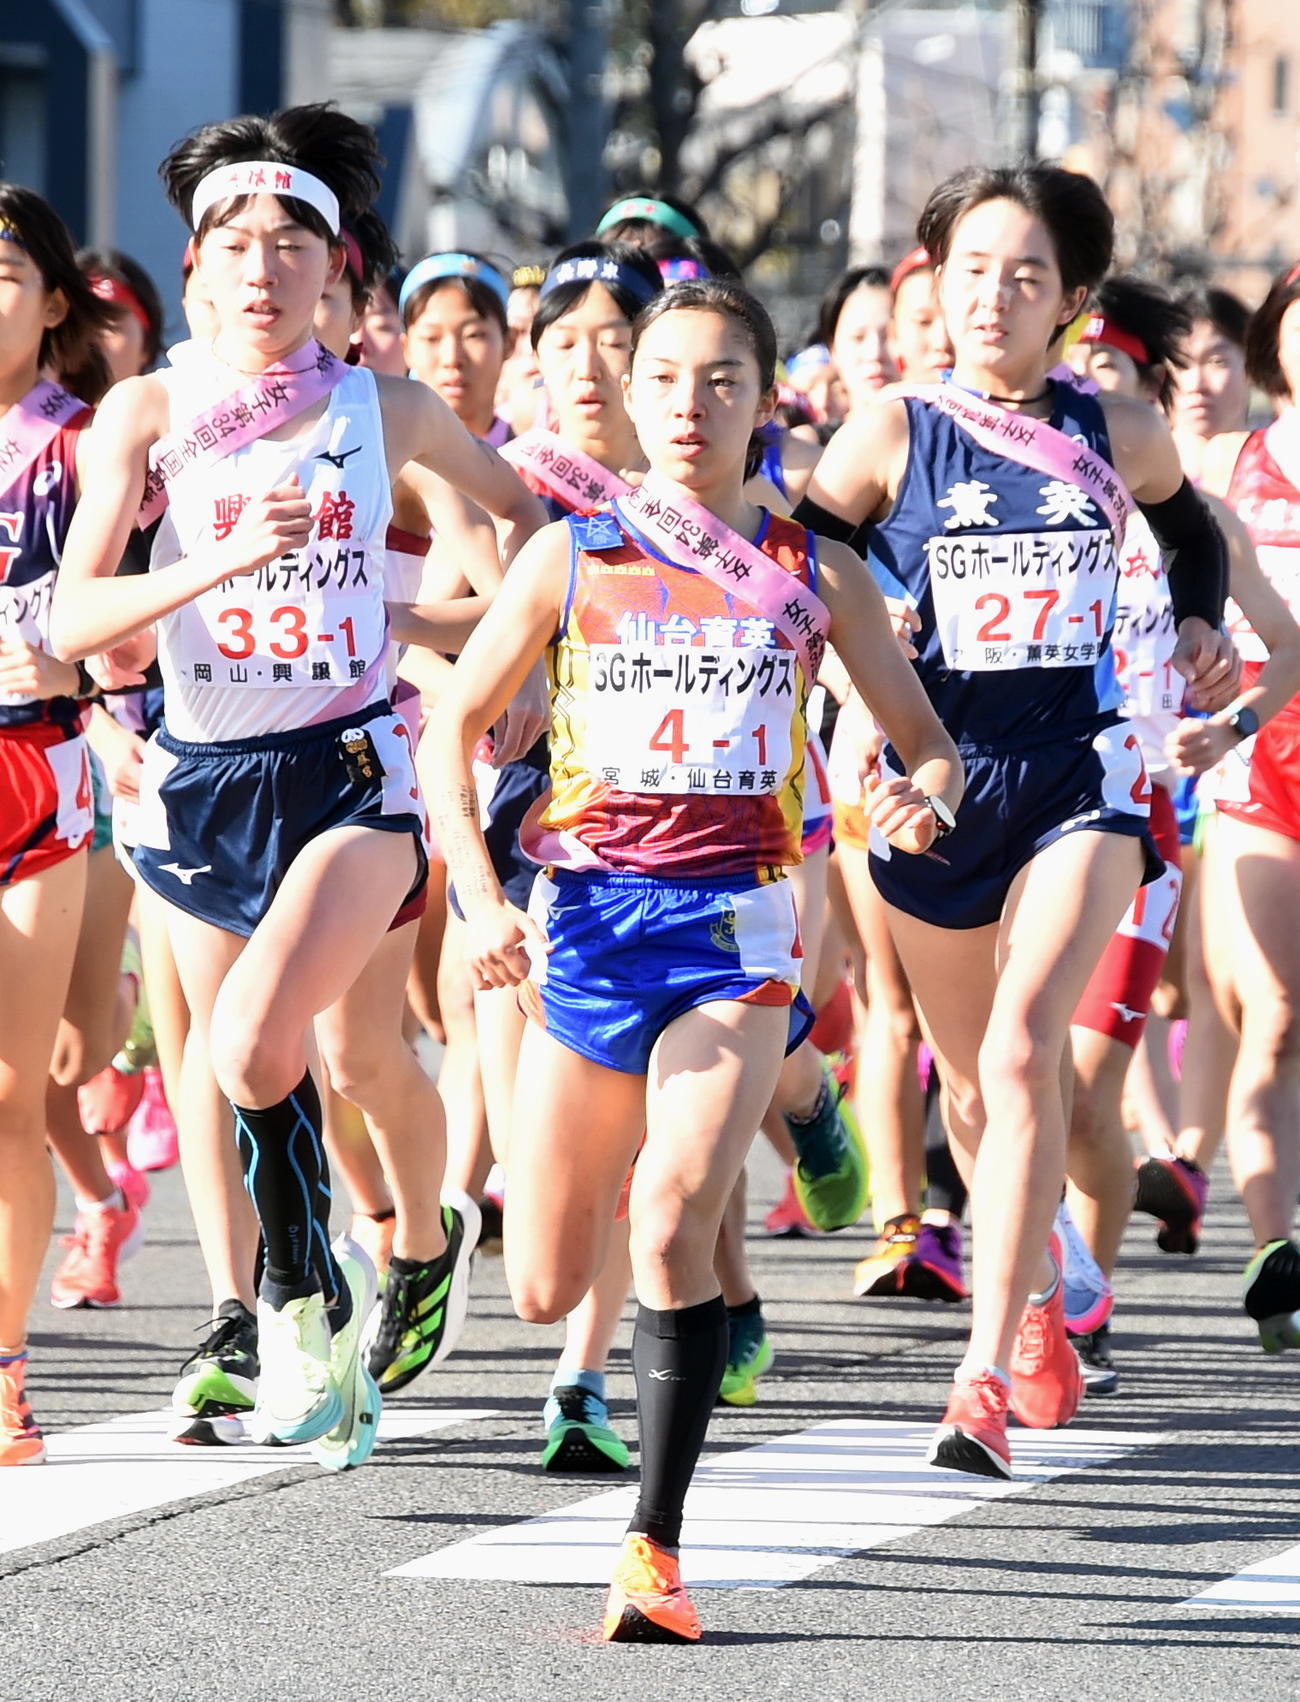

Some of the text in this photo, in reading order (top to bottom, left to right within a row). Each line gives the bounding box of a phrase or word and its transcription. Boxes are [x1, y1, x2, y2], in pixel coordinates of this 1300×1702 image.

[213, 490, 356, 541] 興館
[214, 547, 369, 594] ルディングス
[216, 605, 358, 661] 33-1
[616, 610, 777, 649] 仙台育英
[974, 588, 1103, 643] 27-1
[594, 651, 793, 699] SGホールディングス
[952, 641, 1103, 664] 阪・薫英女学
[602, 765, 778, 791] 宮城・仙台育英
